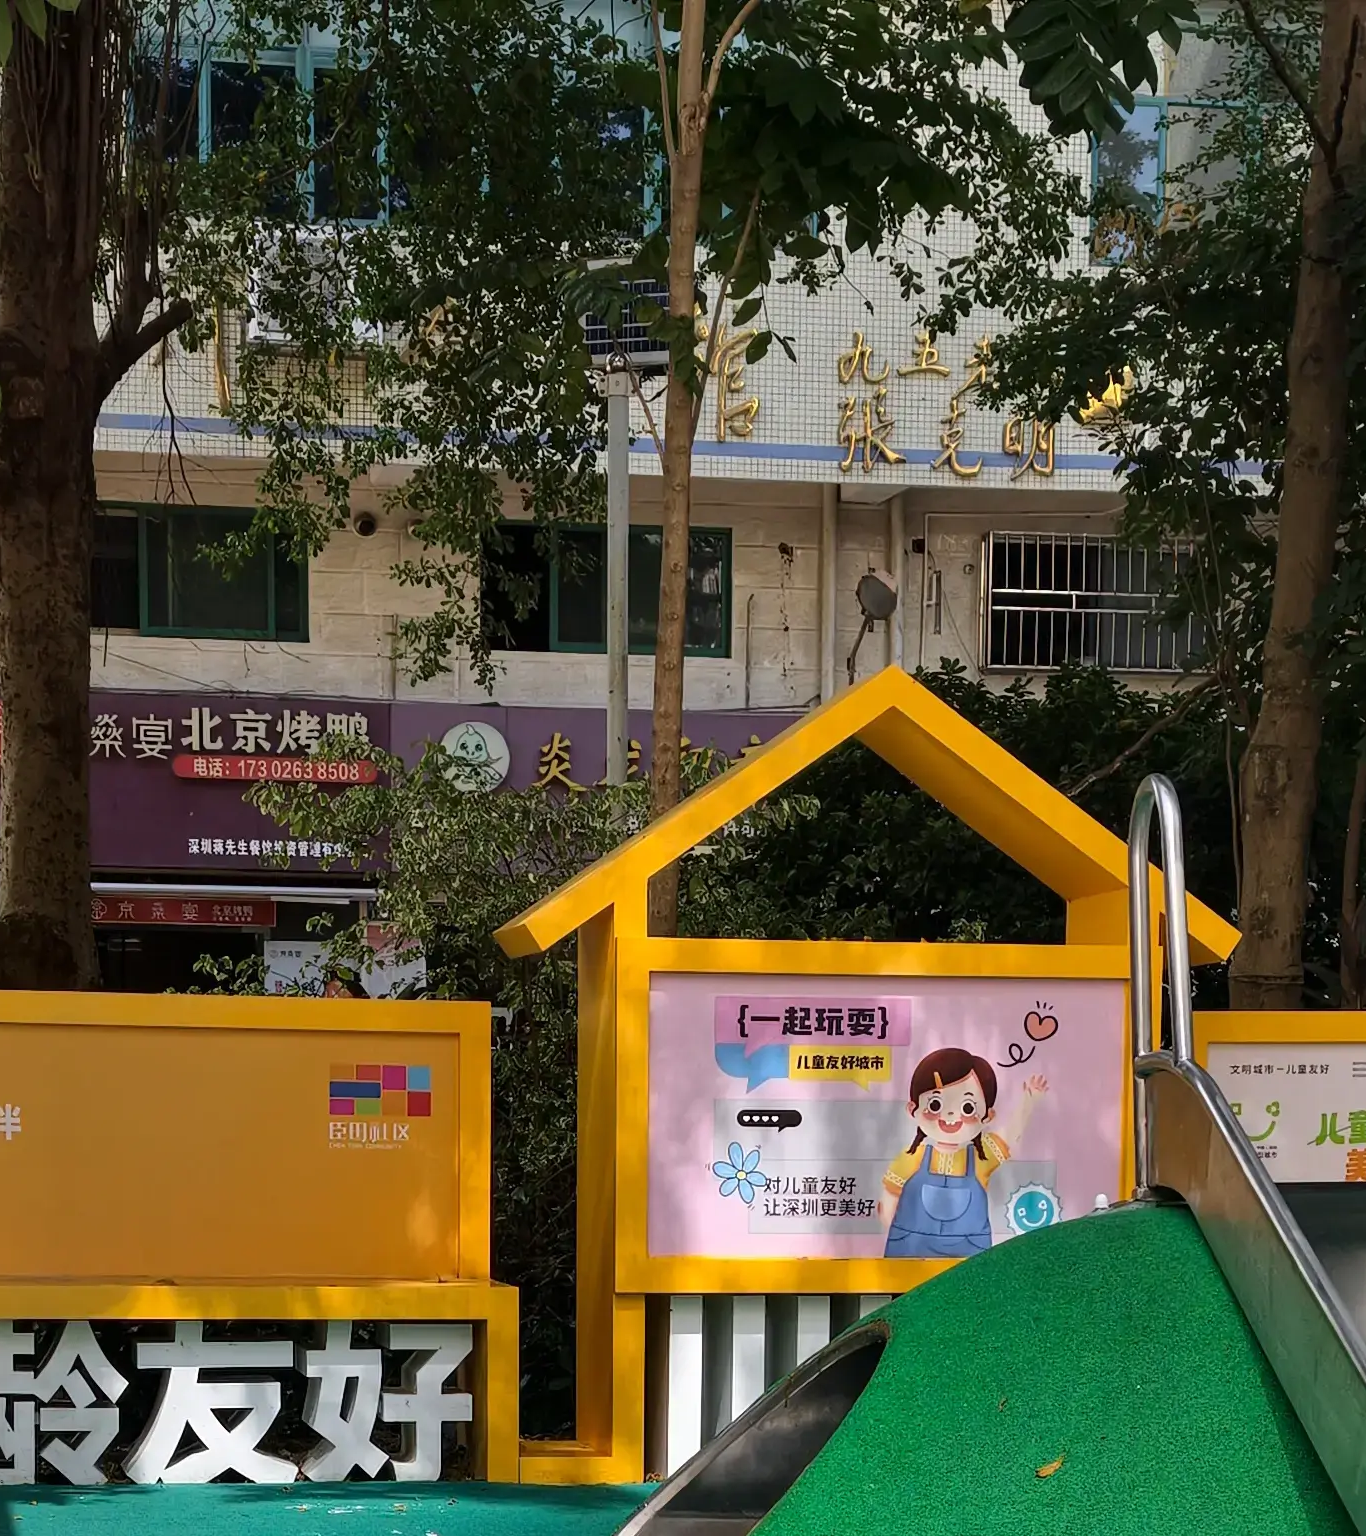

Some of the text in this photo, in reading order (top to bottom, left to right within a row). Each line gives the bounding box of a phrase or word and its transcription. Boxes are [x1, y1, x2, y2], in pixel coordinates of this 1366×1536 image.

[180, 707, 371, 753] 北京烤鸭
[796, 1054, 885, 1071] 儿童友好城市
[764, 1176, 857, 1195] 对儿童友好
[764, 1198, 875, 1217] 让深圳更美好
